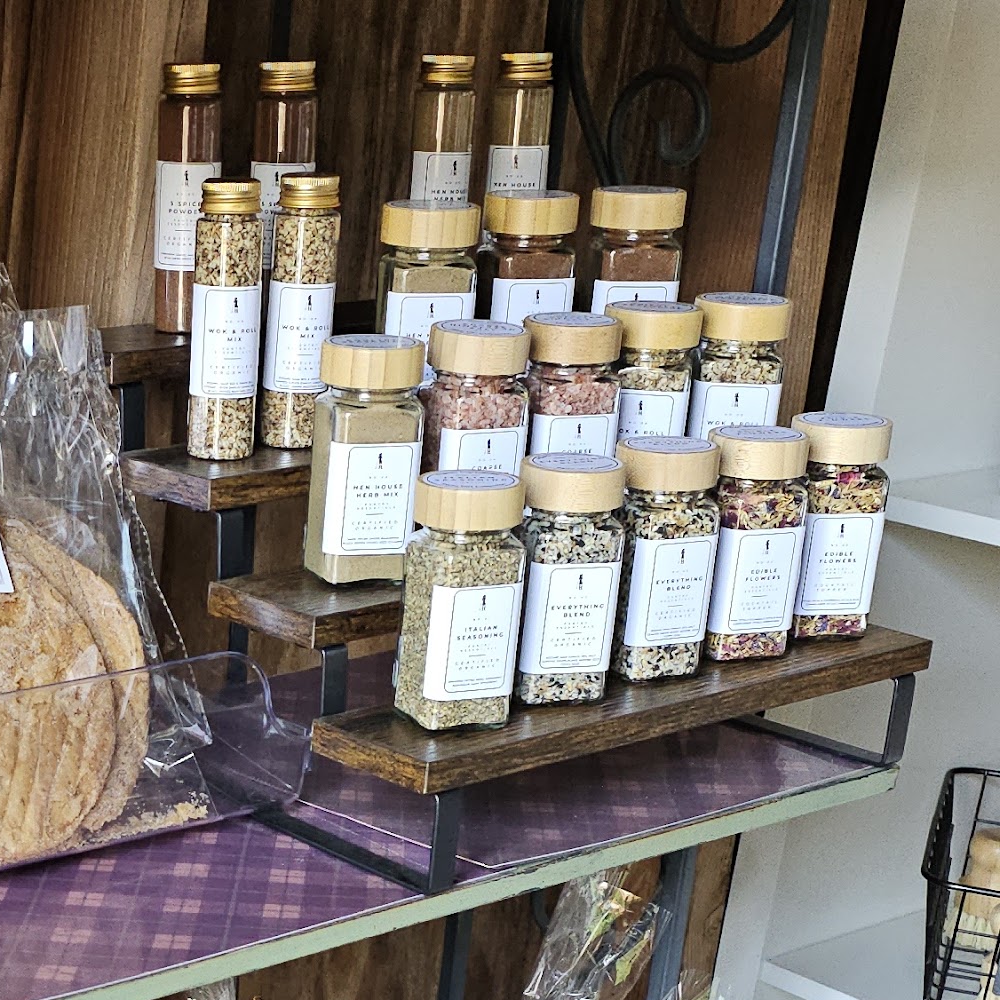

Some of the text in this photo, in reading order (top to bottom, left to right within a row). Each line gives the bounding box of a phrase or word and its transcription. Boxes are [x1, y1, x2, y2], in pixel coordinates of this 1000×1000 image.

[656, 576, 703, 585] EVERYTHING
[551, 603, 605, 611] EVERYTHING
[457, 632, 504, 641] SEASONING
